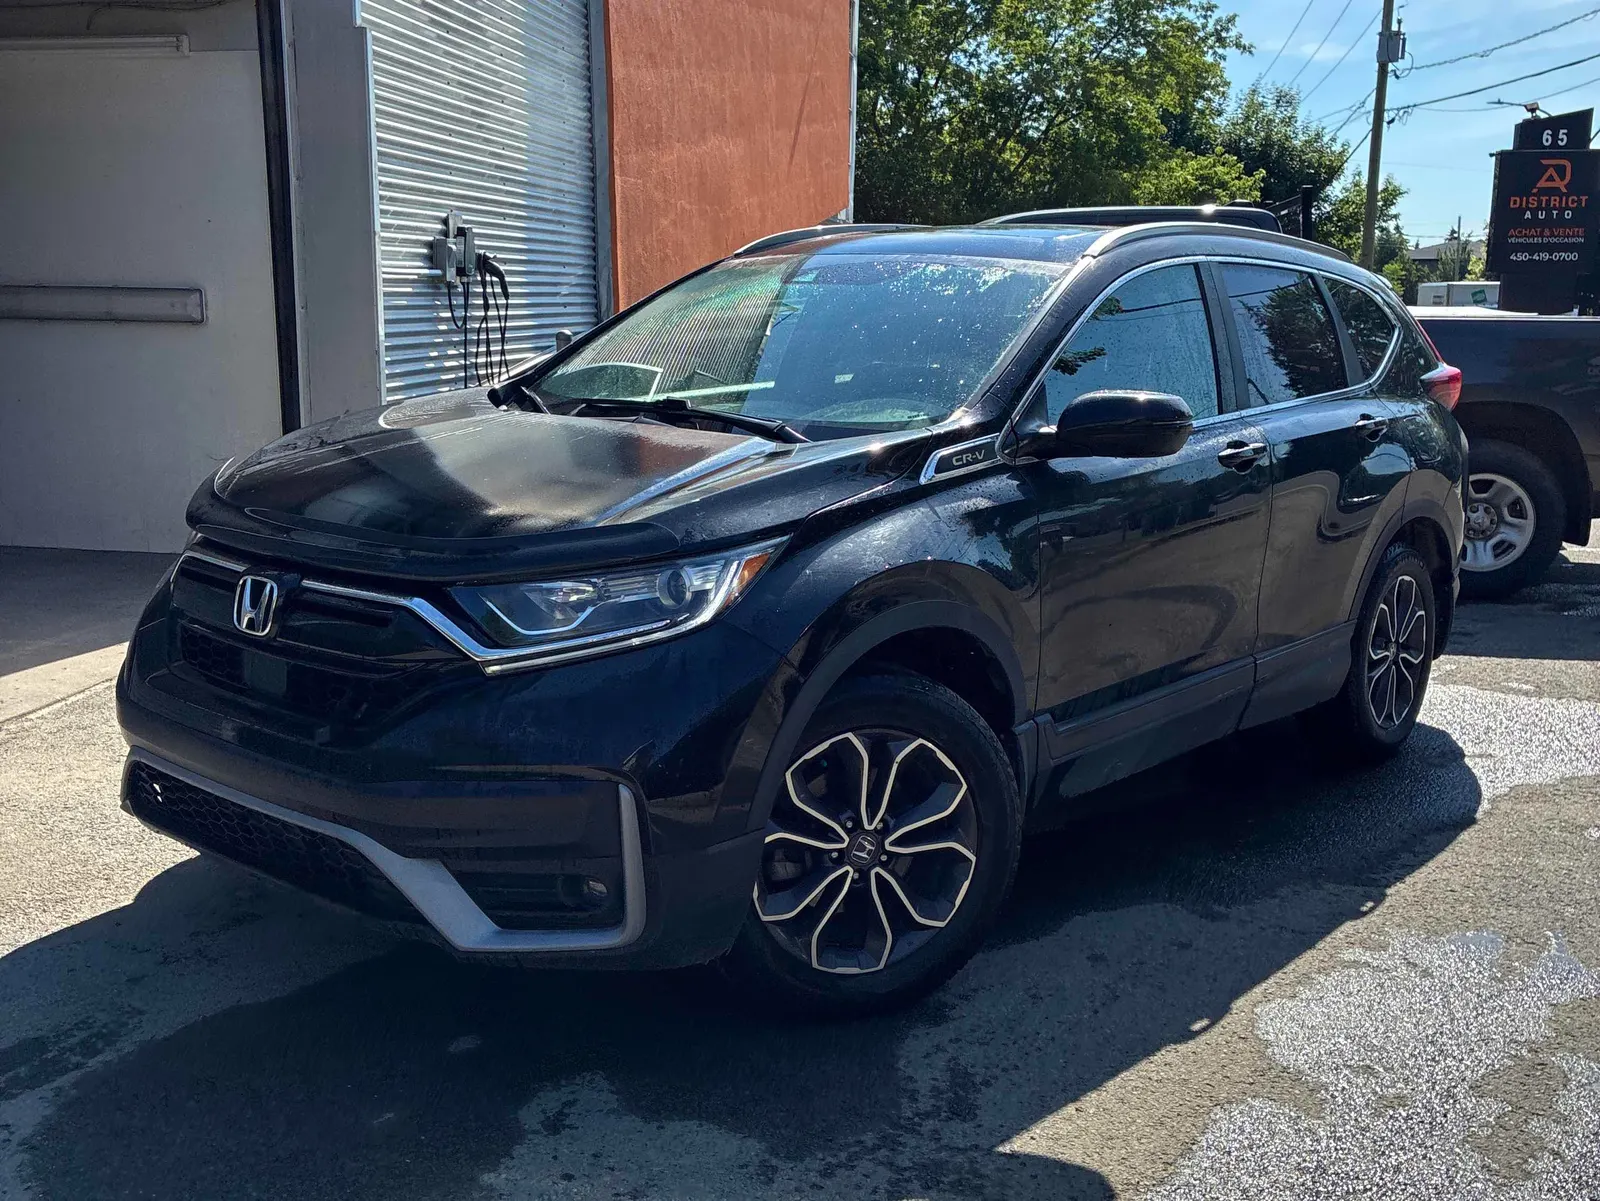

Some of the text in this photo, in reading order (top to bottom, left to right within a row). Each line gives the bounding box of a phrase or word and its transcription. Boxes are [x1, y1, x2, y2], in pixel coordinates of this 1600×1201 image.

[1542, 129, 1568, 146] 65
[1509, 195, 1588, 208] DISTRICT
[1524, 210, 1572, 219] AUTO
[1508, 228, 1585, 236] ACHAT & VENTE
[1509, 252, 1579, 261] 450-419-0700
[952, 449, 985, 466] CR-V
